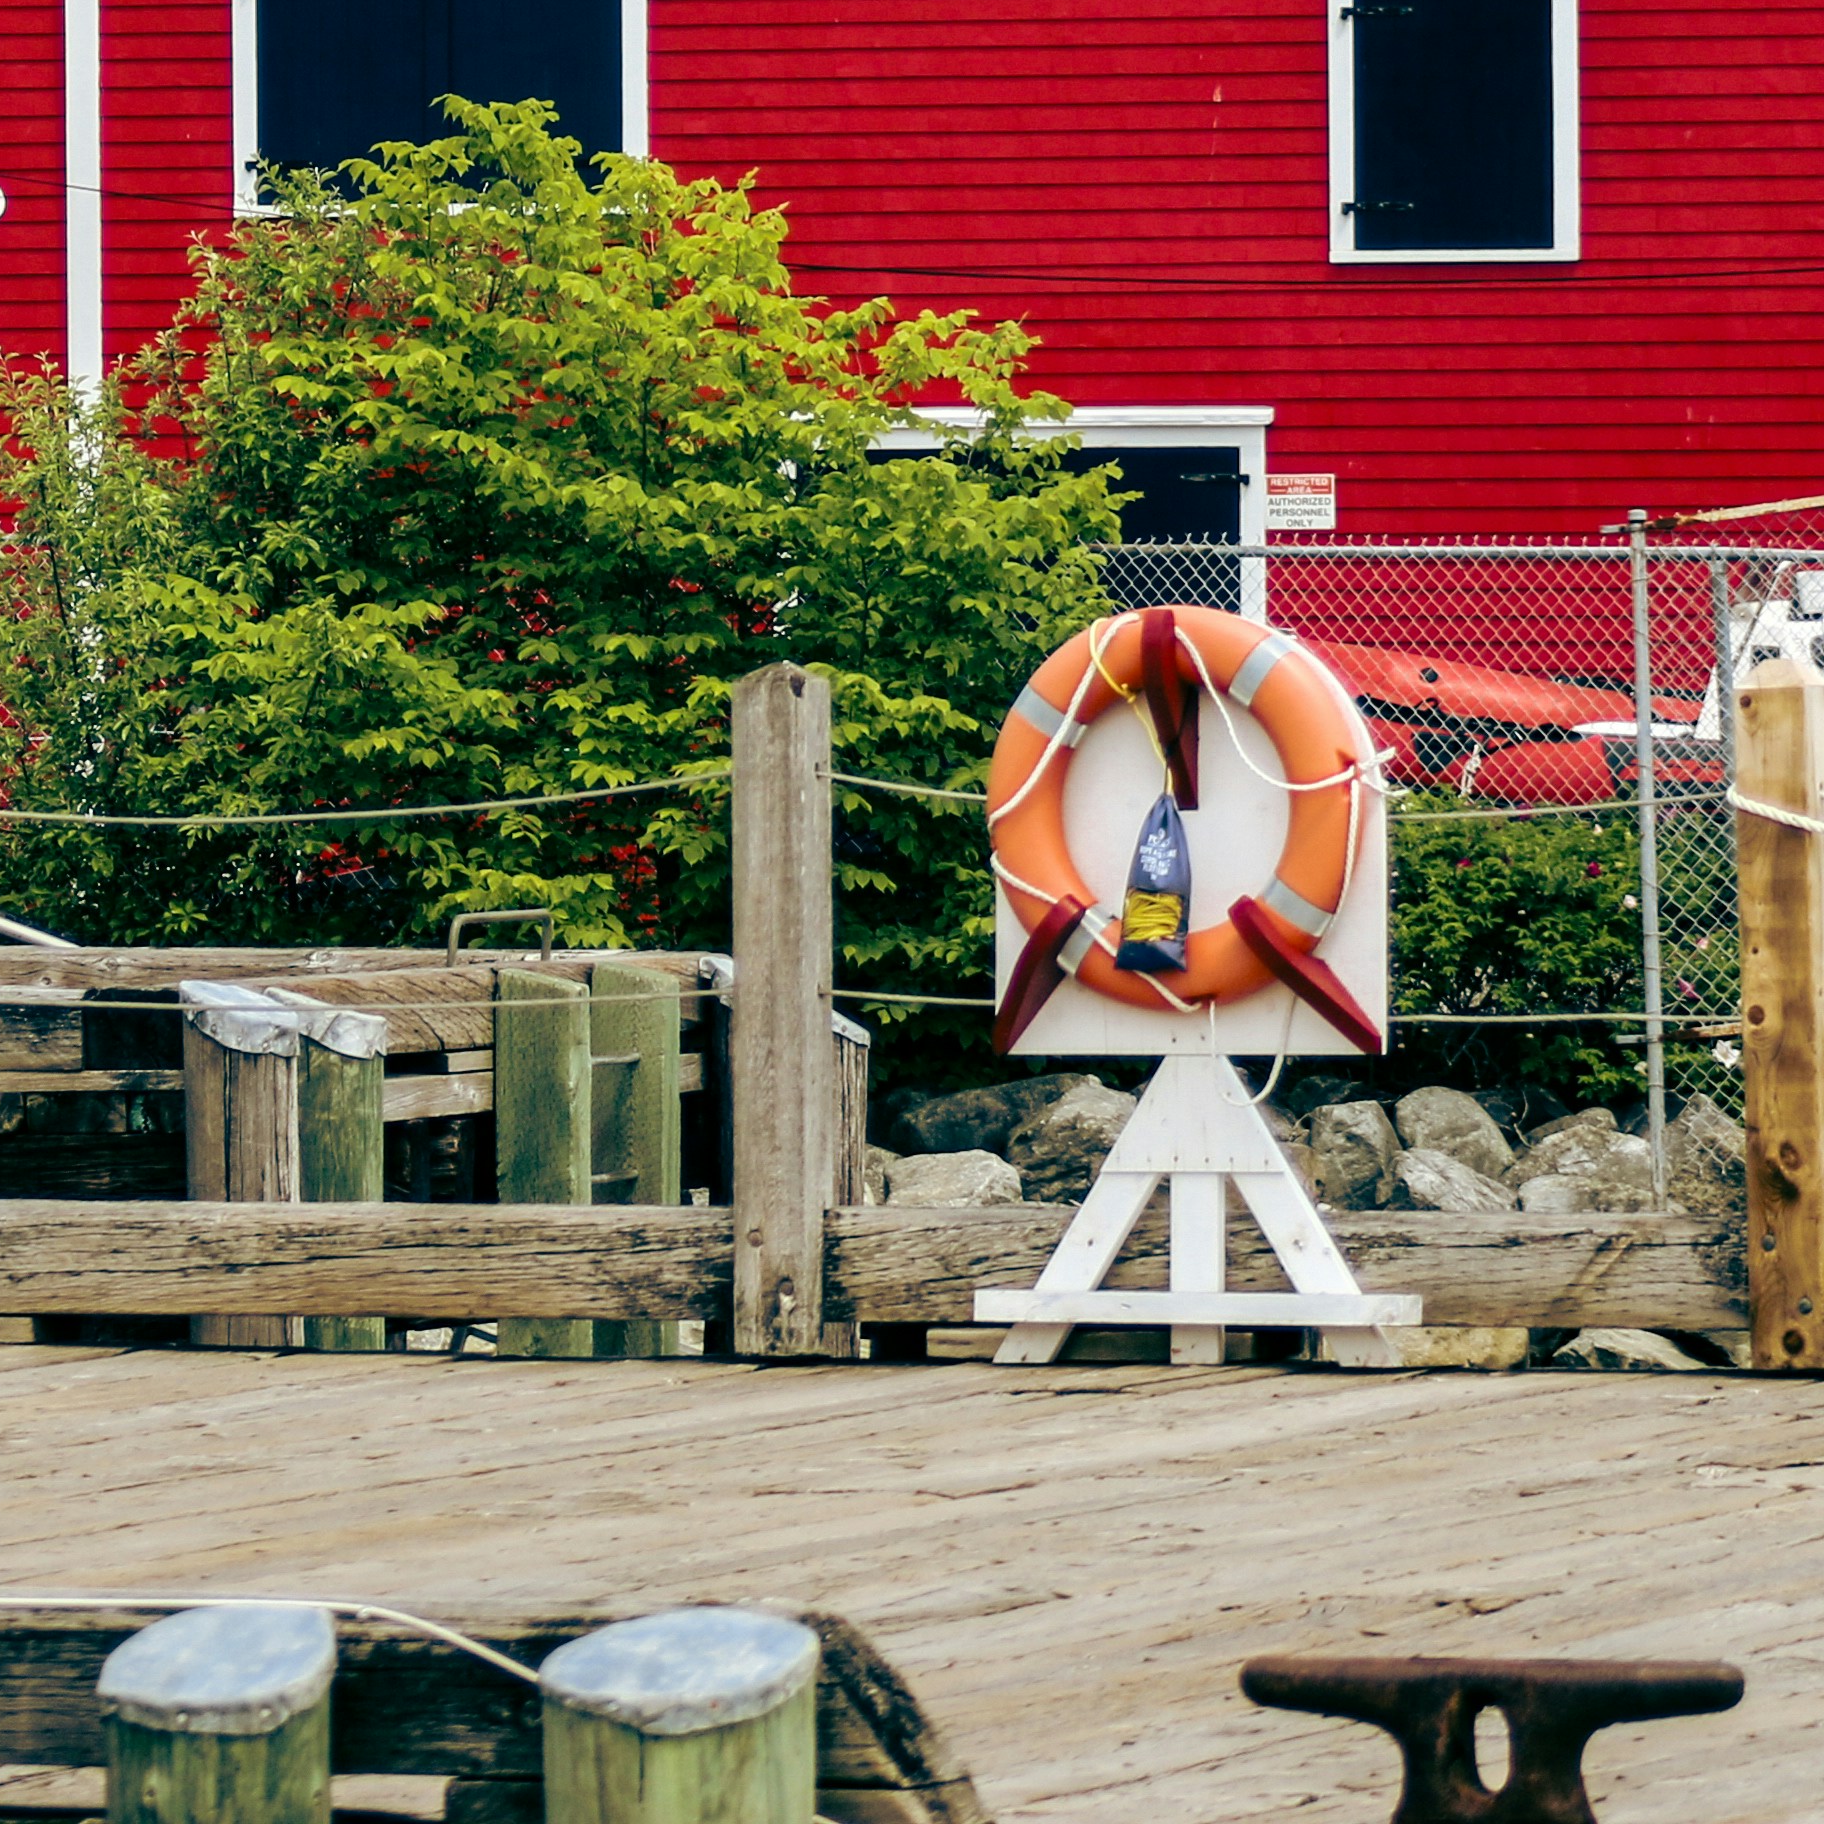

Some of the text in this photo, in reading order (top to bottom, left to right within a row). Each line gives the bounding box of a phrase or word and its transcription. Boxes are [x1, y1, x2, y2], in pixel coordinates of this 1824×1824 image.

[1270, 477, 1329, 486] RESTRICTED
[1286, 486, 1313, 494] AREA
[1268, 497, 1331, 506] AUTHORIZED
[1269, 508, 1331, 517] PERSONNEL
[1286, 519, 1314, 528] ONLY
